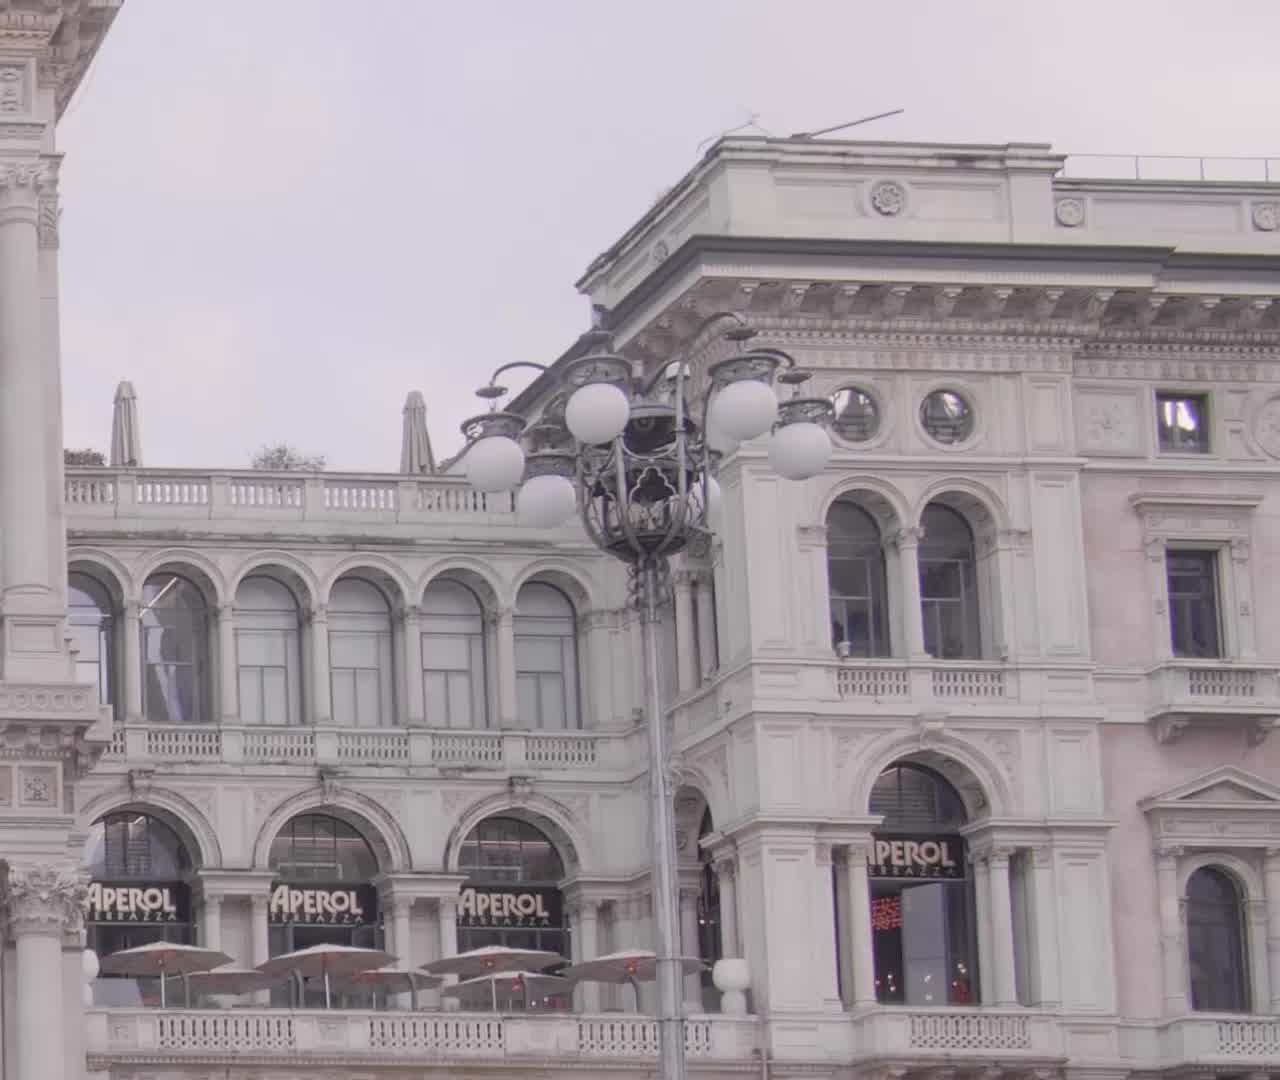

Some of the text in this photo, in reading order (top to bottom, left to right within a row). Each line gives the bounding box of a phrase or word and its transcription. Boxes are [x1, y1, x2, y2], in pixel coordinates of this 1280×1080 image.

[89, 883, 176, 913] APEROL
[270, 885, 363, 914] APEROL
[458, 887, 550, 917] APEROL
